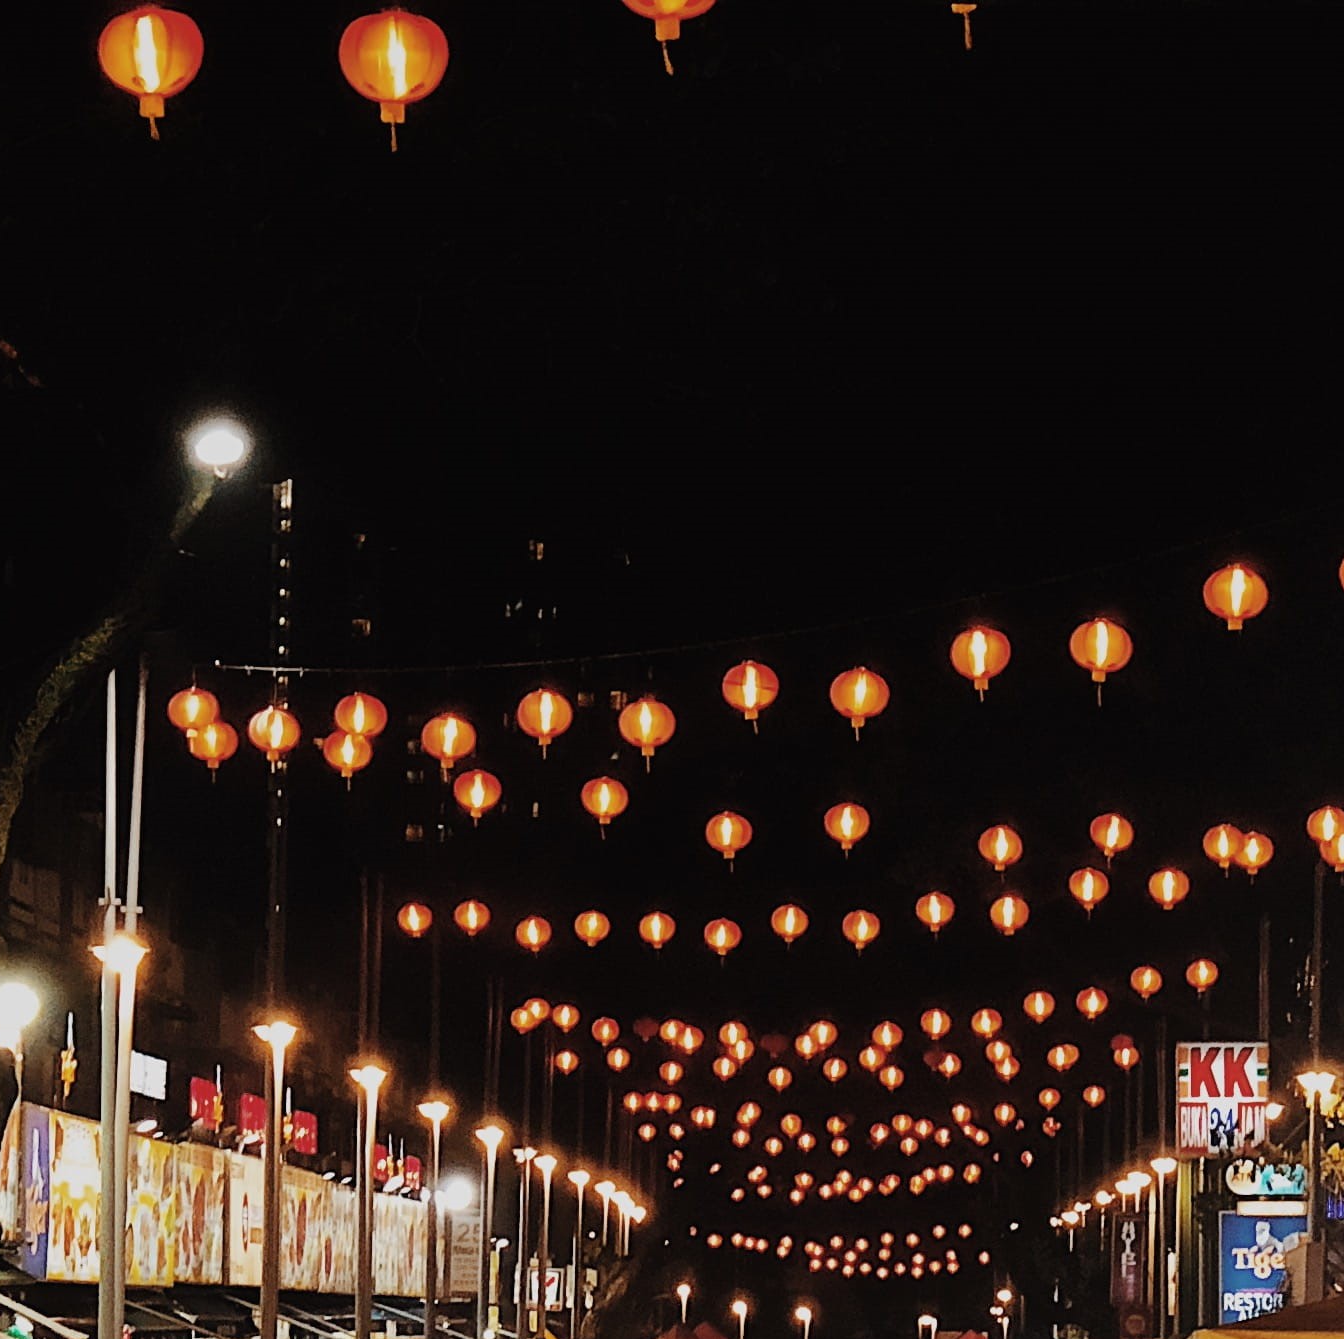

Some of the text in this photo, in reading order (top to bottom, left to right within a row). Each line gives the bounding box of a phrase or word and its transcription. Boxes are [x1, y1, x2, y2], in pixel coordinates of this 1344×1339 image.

[1189, 1046, 1256, 1098] KK
[1180, 1105, 1207, 1149] BUKA
[1231, 1244, 1285, 1279] Tige
